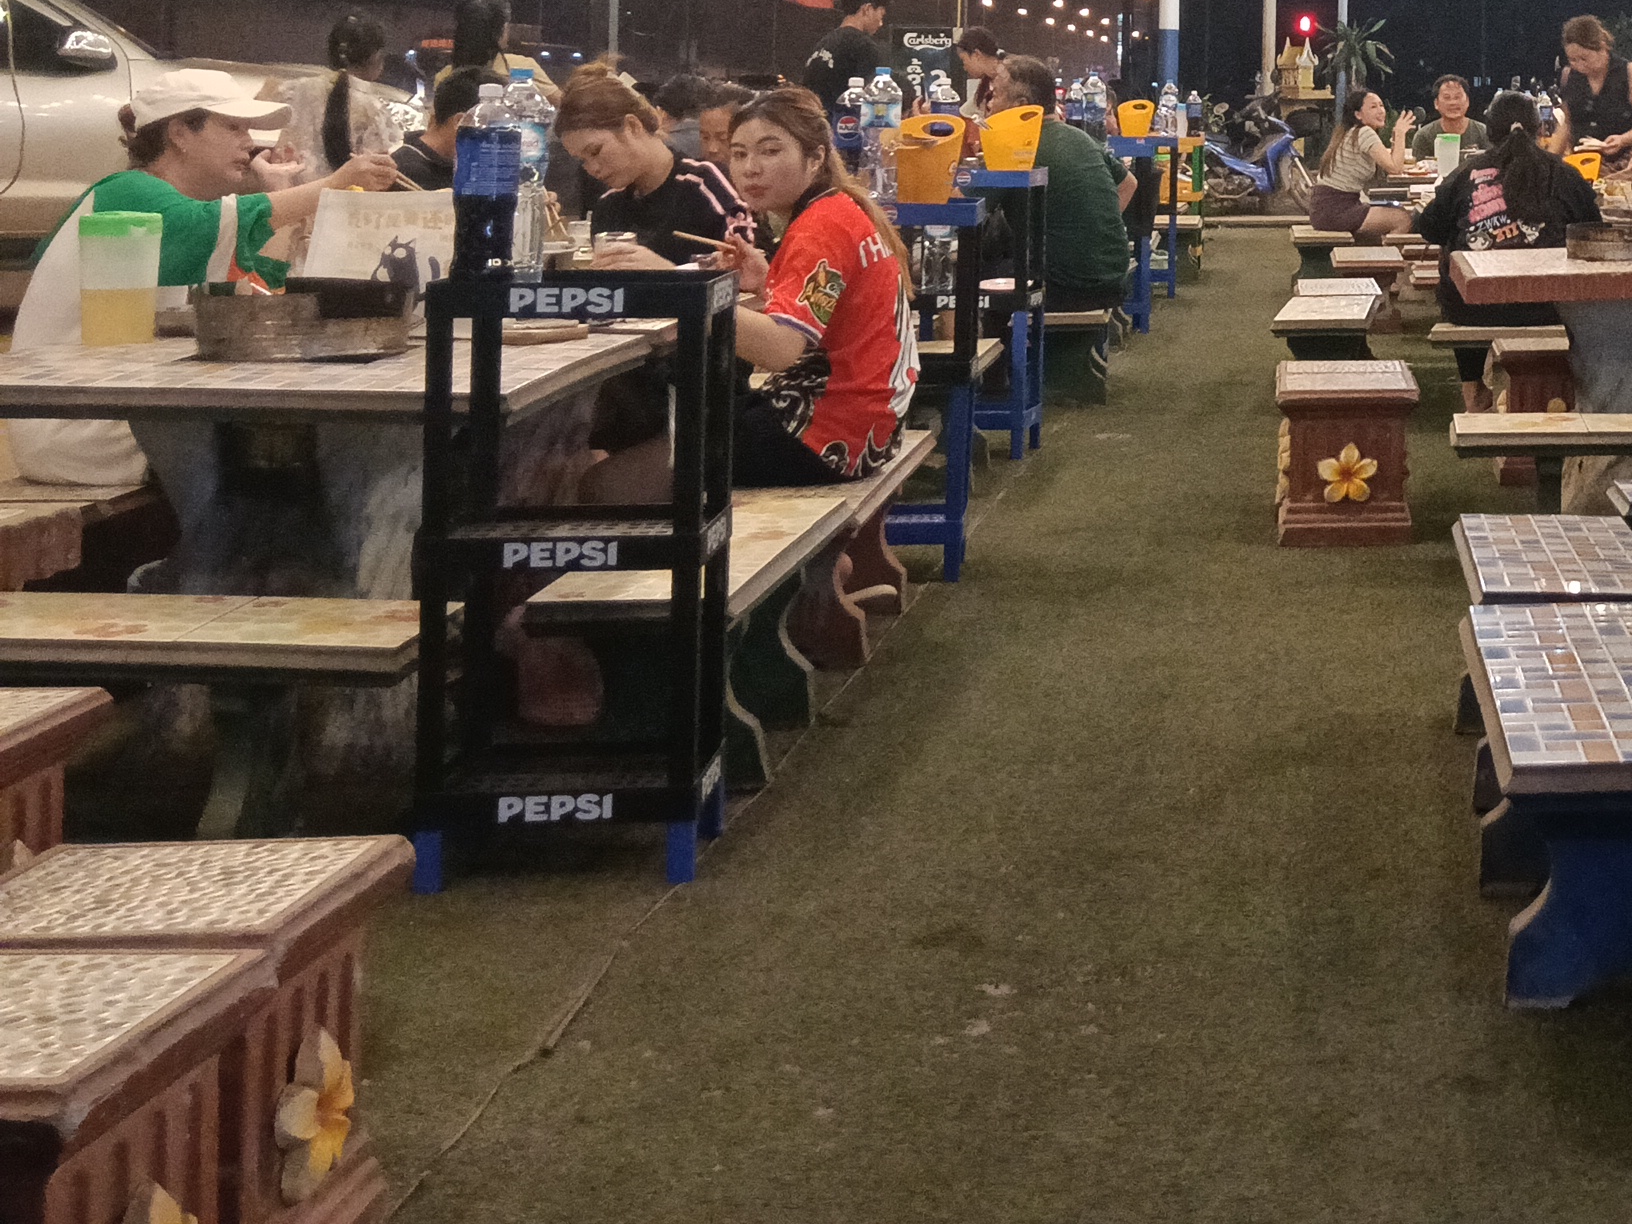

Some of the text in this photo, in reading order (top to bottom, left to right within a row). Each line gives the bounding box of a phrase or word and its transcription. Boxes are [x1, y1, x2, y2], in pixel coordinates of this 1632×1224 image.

[903, 32, 952, 51] Carlsberg
[509, 287, 625, 314] PEPSI
[936, 295, 990, 309] PESI
[502, 540, 618, 569] PEPSI
[497, 793, 614, 823] PEPSI
